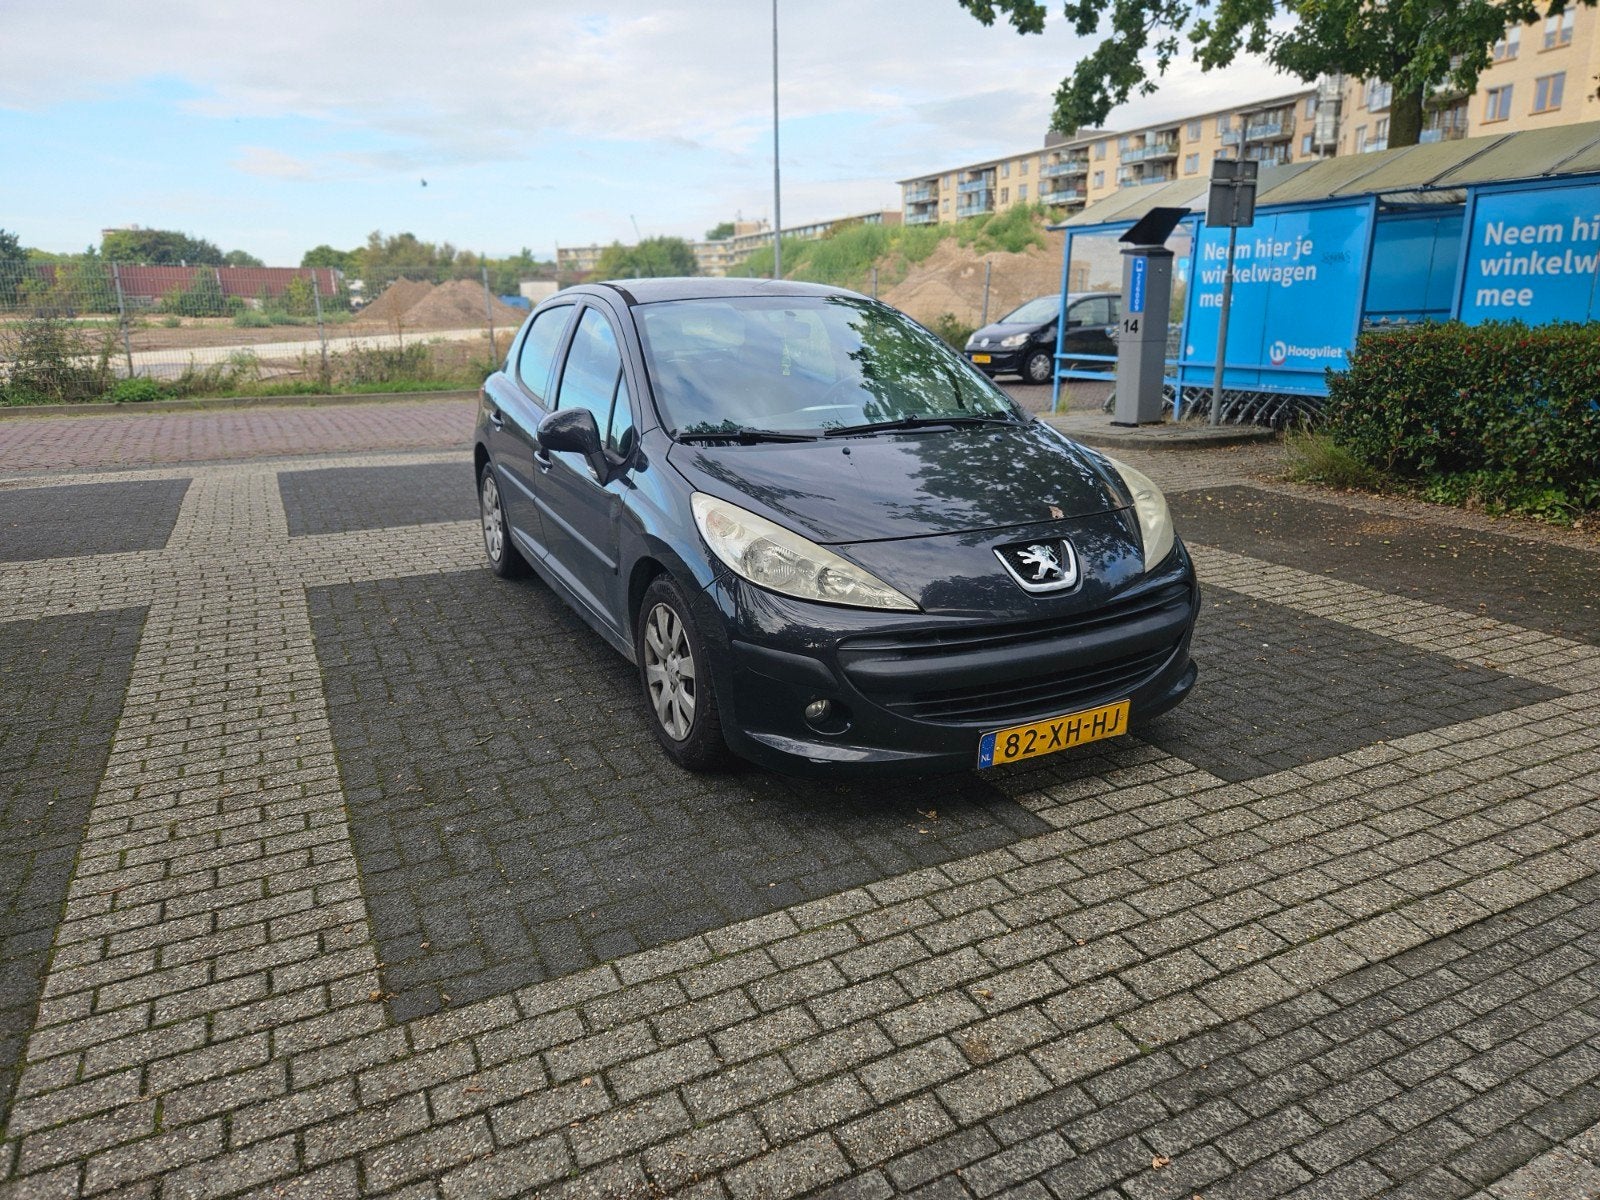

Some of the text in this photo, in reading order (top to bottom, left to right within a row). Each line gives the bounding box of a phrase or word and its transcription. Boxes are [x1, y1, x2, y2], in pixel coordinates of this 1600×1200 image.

[1484, 221, 1563, 246] Neem
[1255, 239, 1292, 258] hier
[1293, 235, 1313, 260] je
[1199, 292, 1234, 308] me
[1475, 288, 1533, 307] mee
[1123, 318, 1139, 334] 14
[1287, 344, 1343, 360] Hoogvliet
[1004, 707, 1120, 758] 82-XH-HJ
[980, 753, 992, 764] NL
